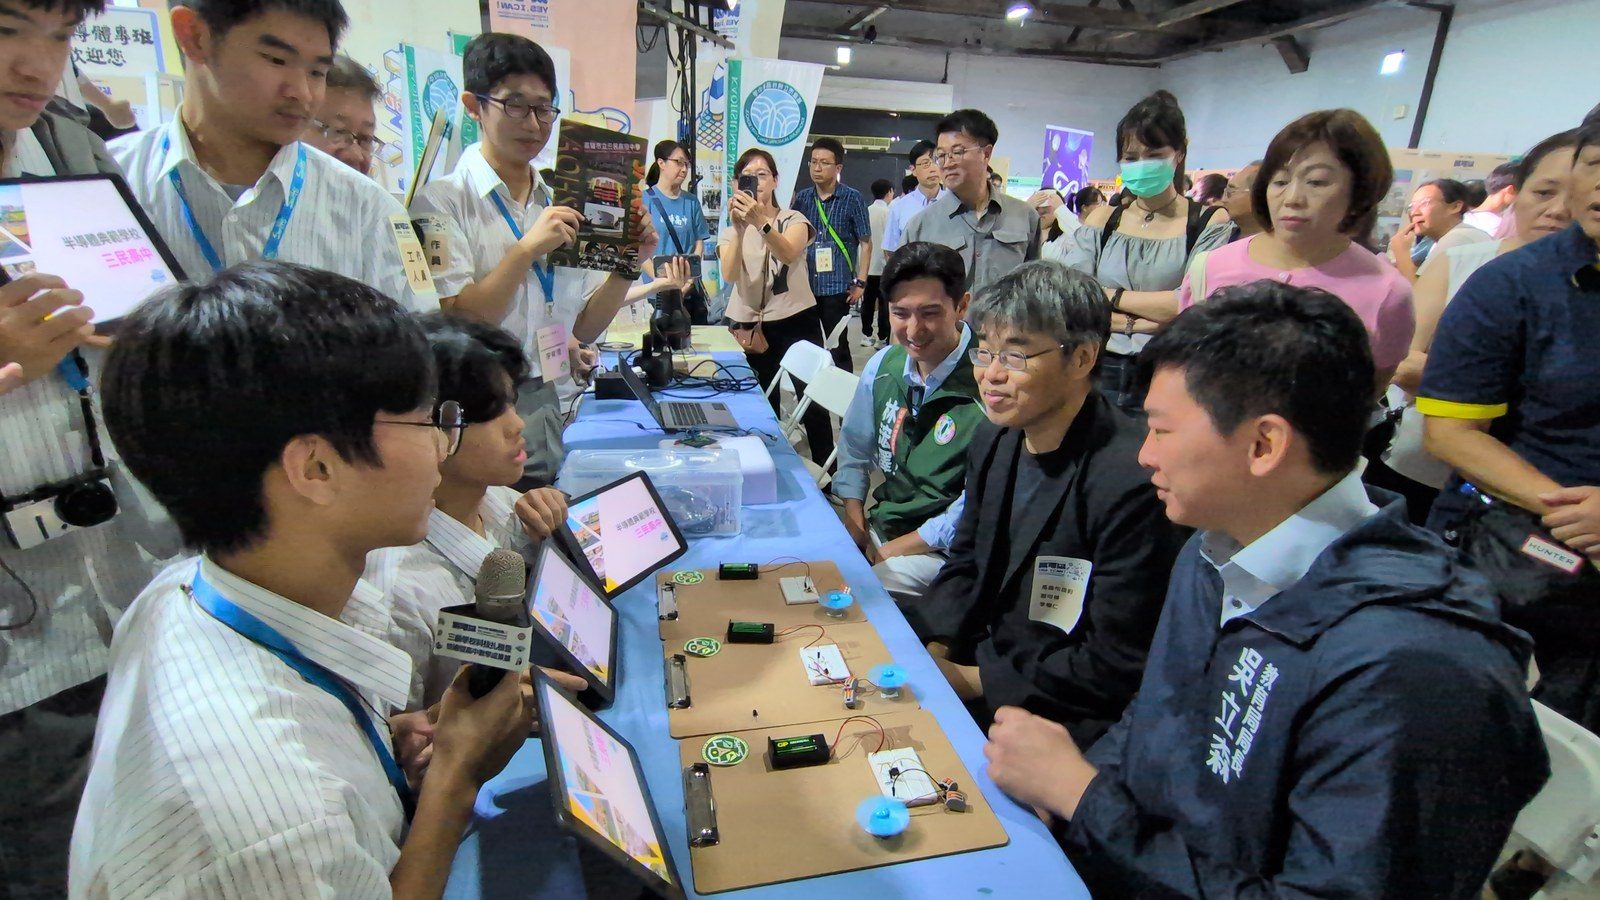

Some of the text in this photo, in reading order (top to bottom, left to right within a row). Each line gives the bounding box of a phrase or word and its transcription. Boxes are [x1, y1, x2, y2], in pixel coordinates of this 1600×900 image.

[101, 247, 153, 269] 三民高中
[1528, 542, 1576, 567] HUNTER
[1205, 646, 1264, 785] 吳立森
[1230, 662, 1281, 779] 教育局局長
[776, 740, 790, 749] GP
